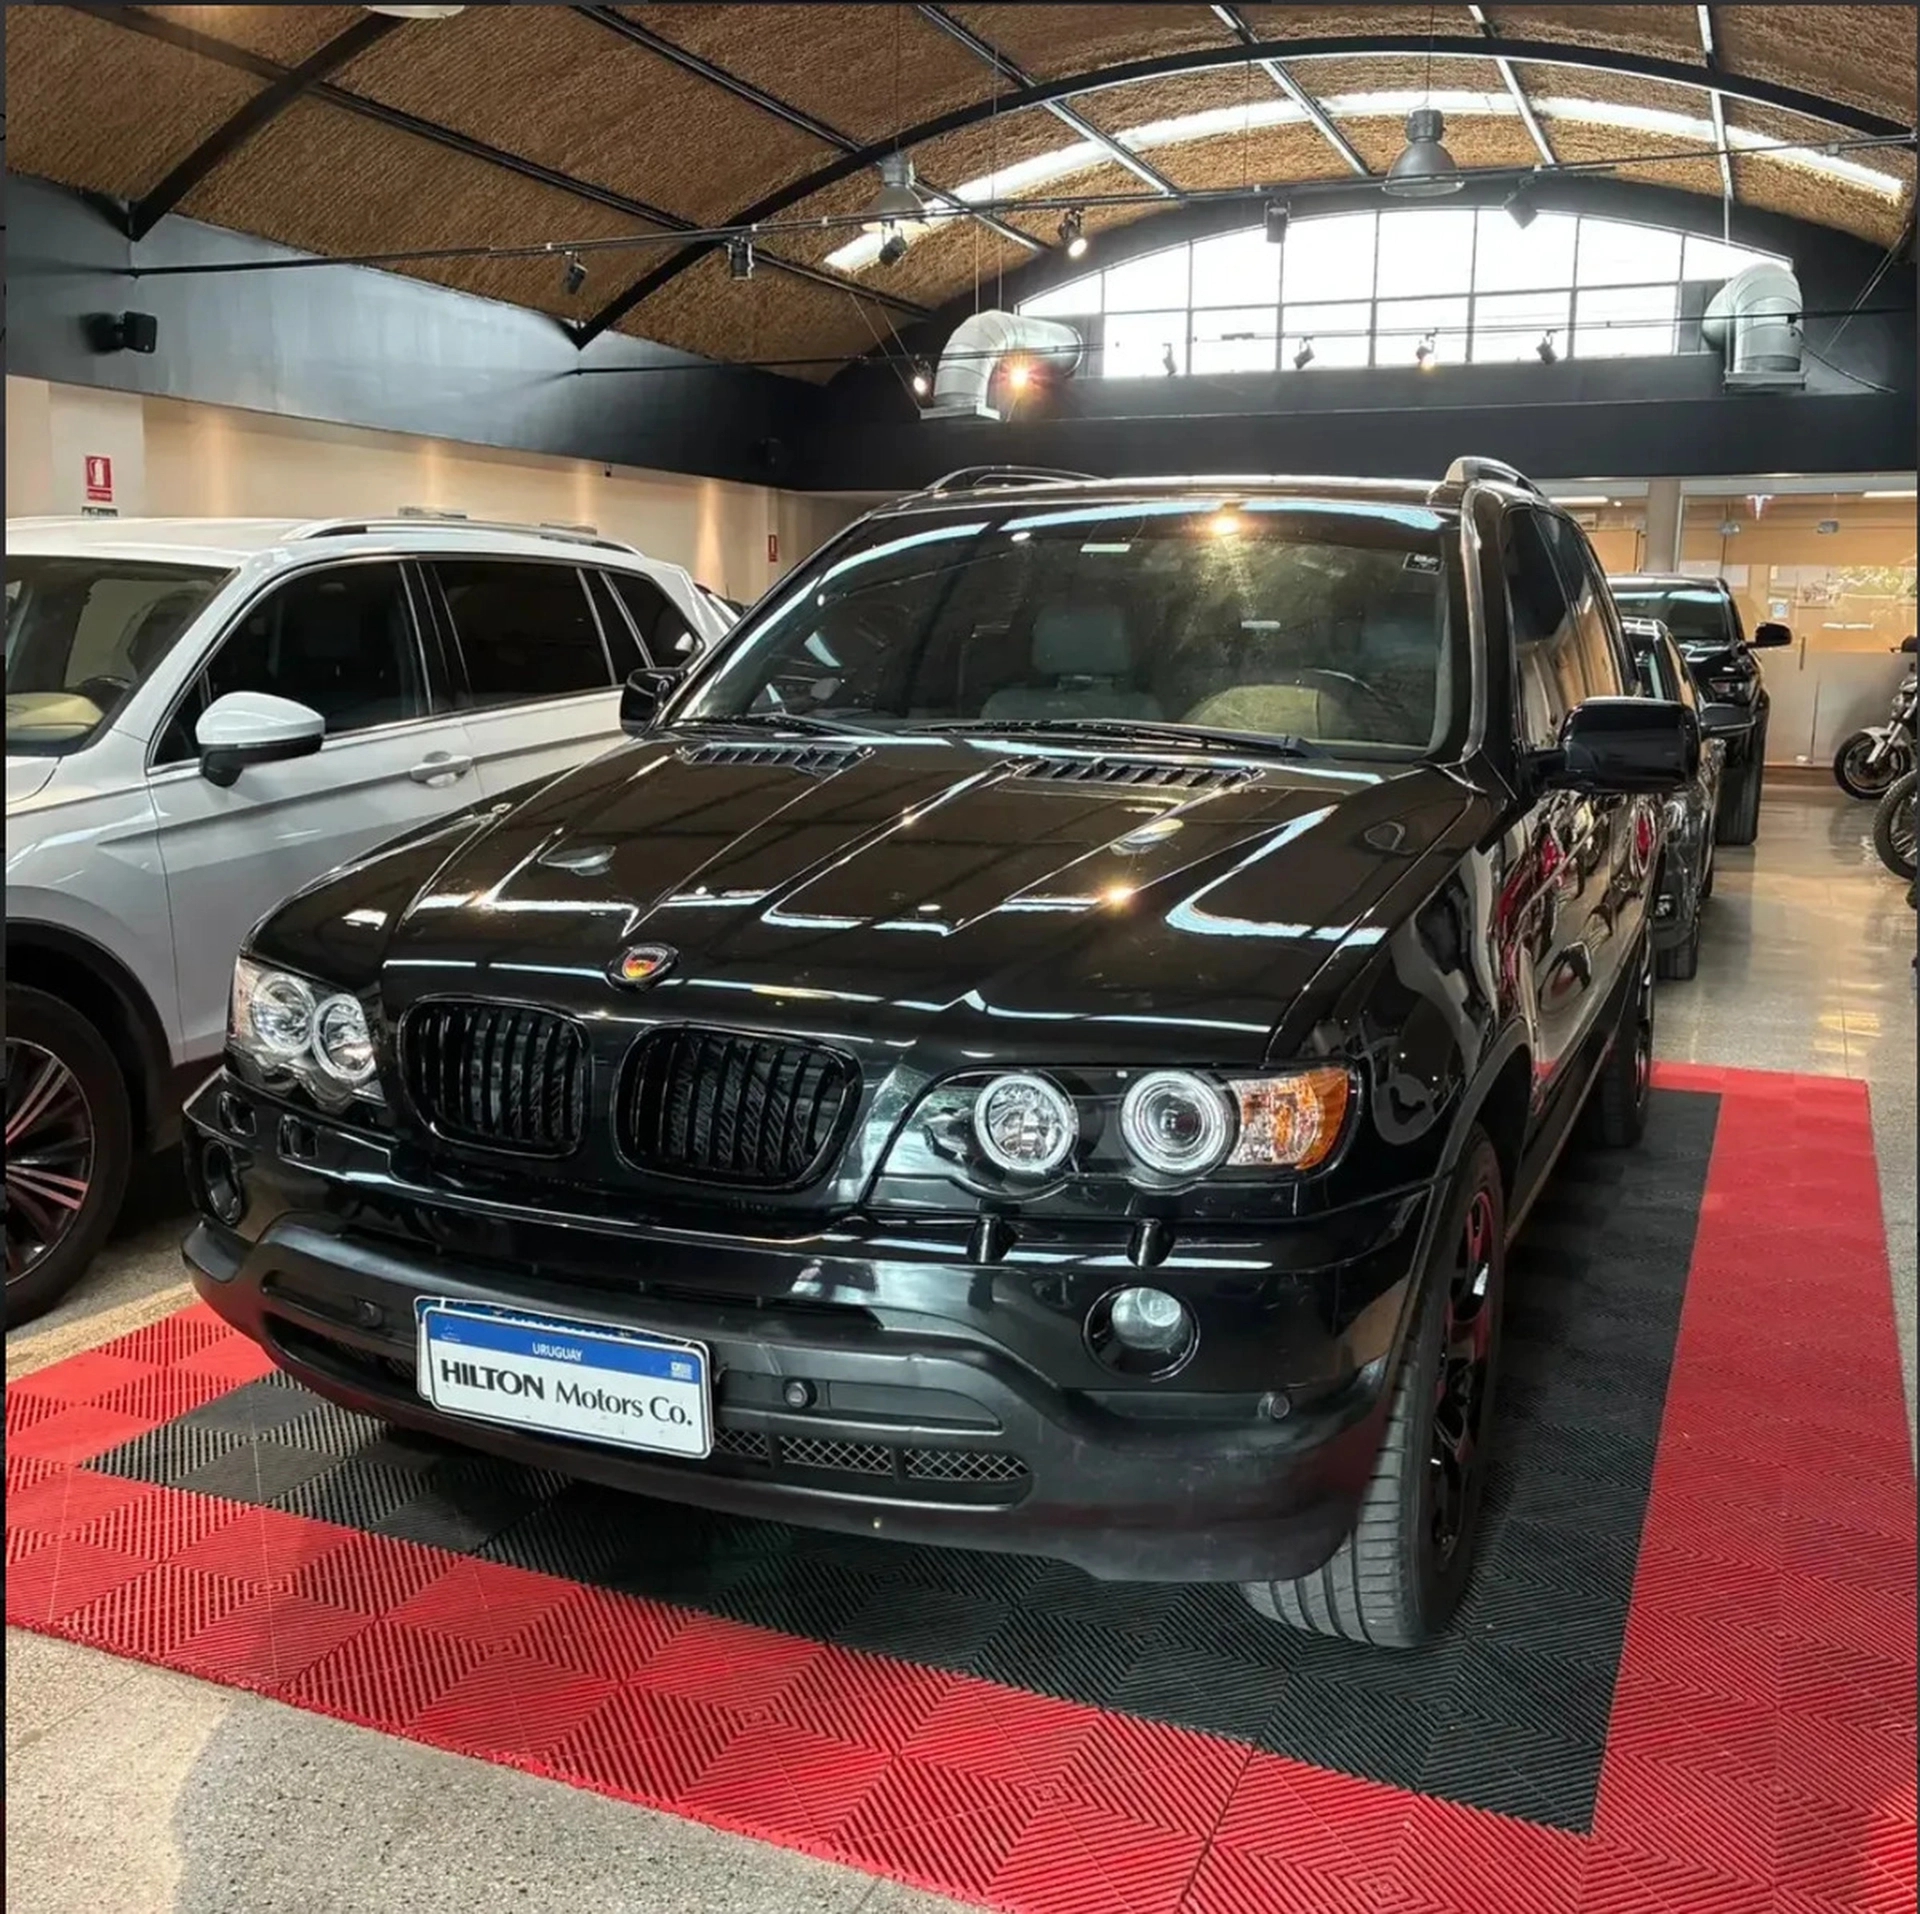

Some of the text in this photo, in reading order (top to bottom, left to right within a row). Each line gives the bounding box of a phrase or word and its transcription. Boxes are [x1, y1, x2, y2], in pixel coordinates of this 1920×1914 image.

[532, 1342, 582, 1361] URUGUAY
[440, 1359, 692, 1426] HILTON Motors Co.
